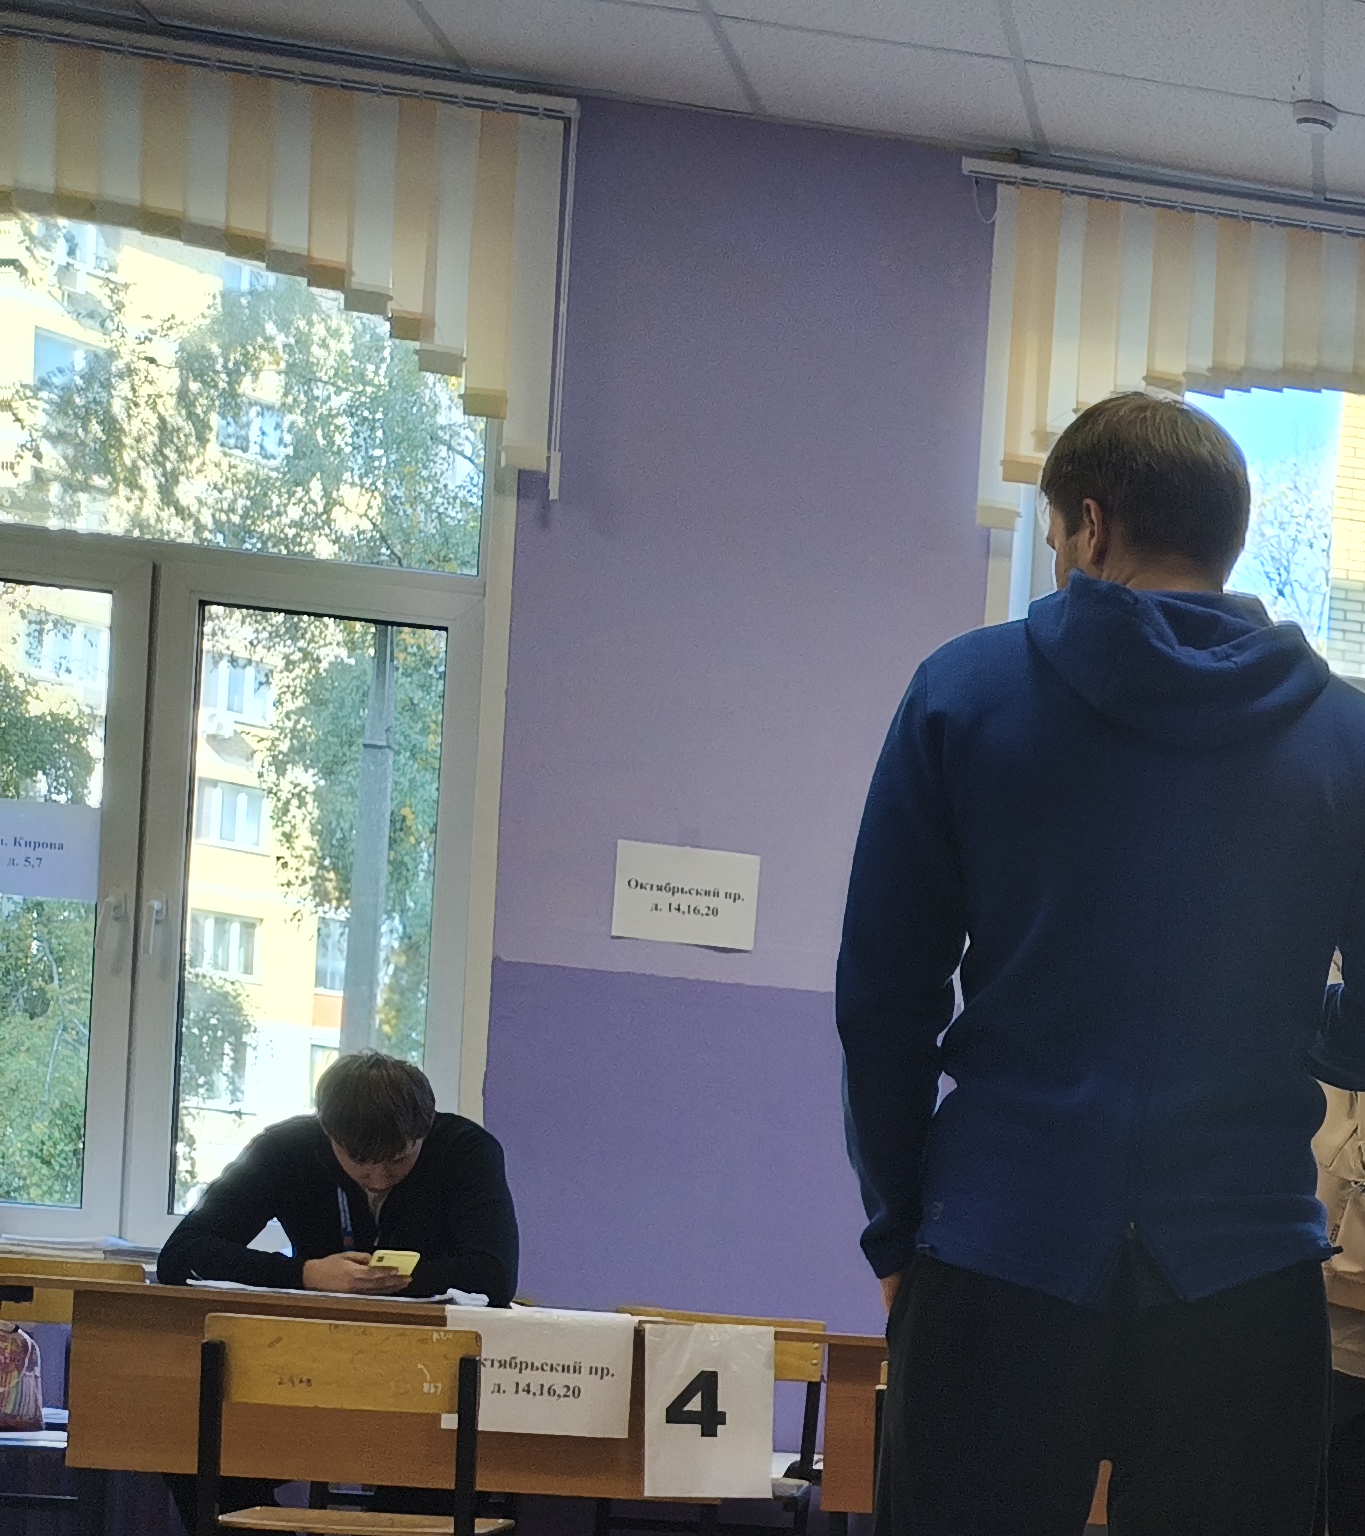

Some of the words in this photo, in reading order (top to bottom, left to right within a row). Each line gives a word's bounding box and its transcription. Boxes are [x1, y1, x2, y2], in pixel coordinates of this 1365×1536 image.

[13, 836, 64, 851] Кирова
[7, 857, 19, 867] д.
[23, 856, 43, 868] 5,7
[627, 877, 720, 898] Октябрьский
[724, 890, 745, 903] пр.
[650, 902, 663, 912] д.
[667, 902, 719, 917] 14,16,20
[480, 1356, 582, 1375] ктябрьский
[588, 1364, 615, 1380] пр.
[490, 1382, 507, 1395] д.
[513, 1380, 582, 1400] 14,16,20
[665, 1370, 727, 1437] 4
